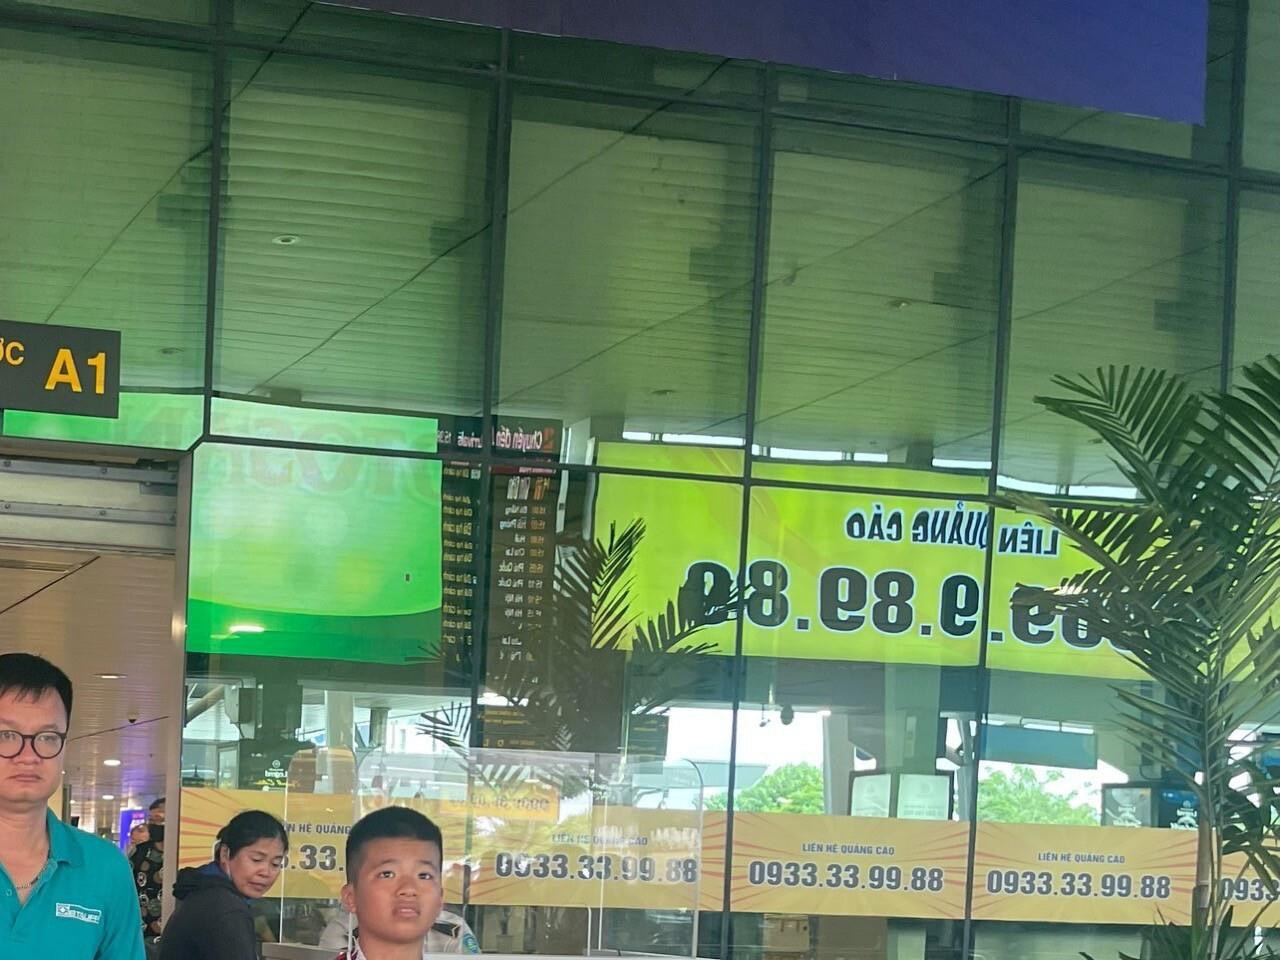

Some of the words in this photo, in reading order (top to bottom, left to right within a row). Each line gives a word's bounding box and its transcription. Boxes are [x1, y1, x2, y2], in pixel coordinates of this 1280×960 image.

[44, 347, 107, 395] A1
[495, 852, 698, 883] 0933.33.99.88
[748, 861, 945, 892] 0933.33.99.88
[986, 869, 1171, 899] 0933.33.99.88
